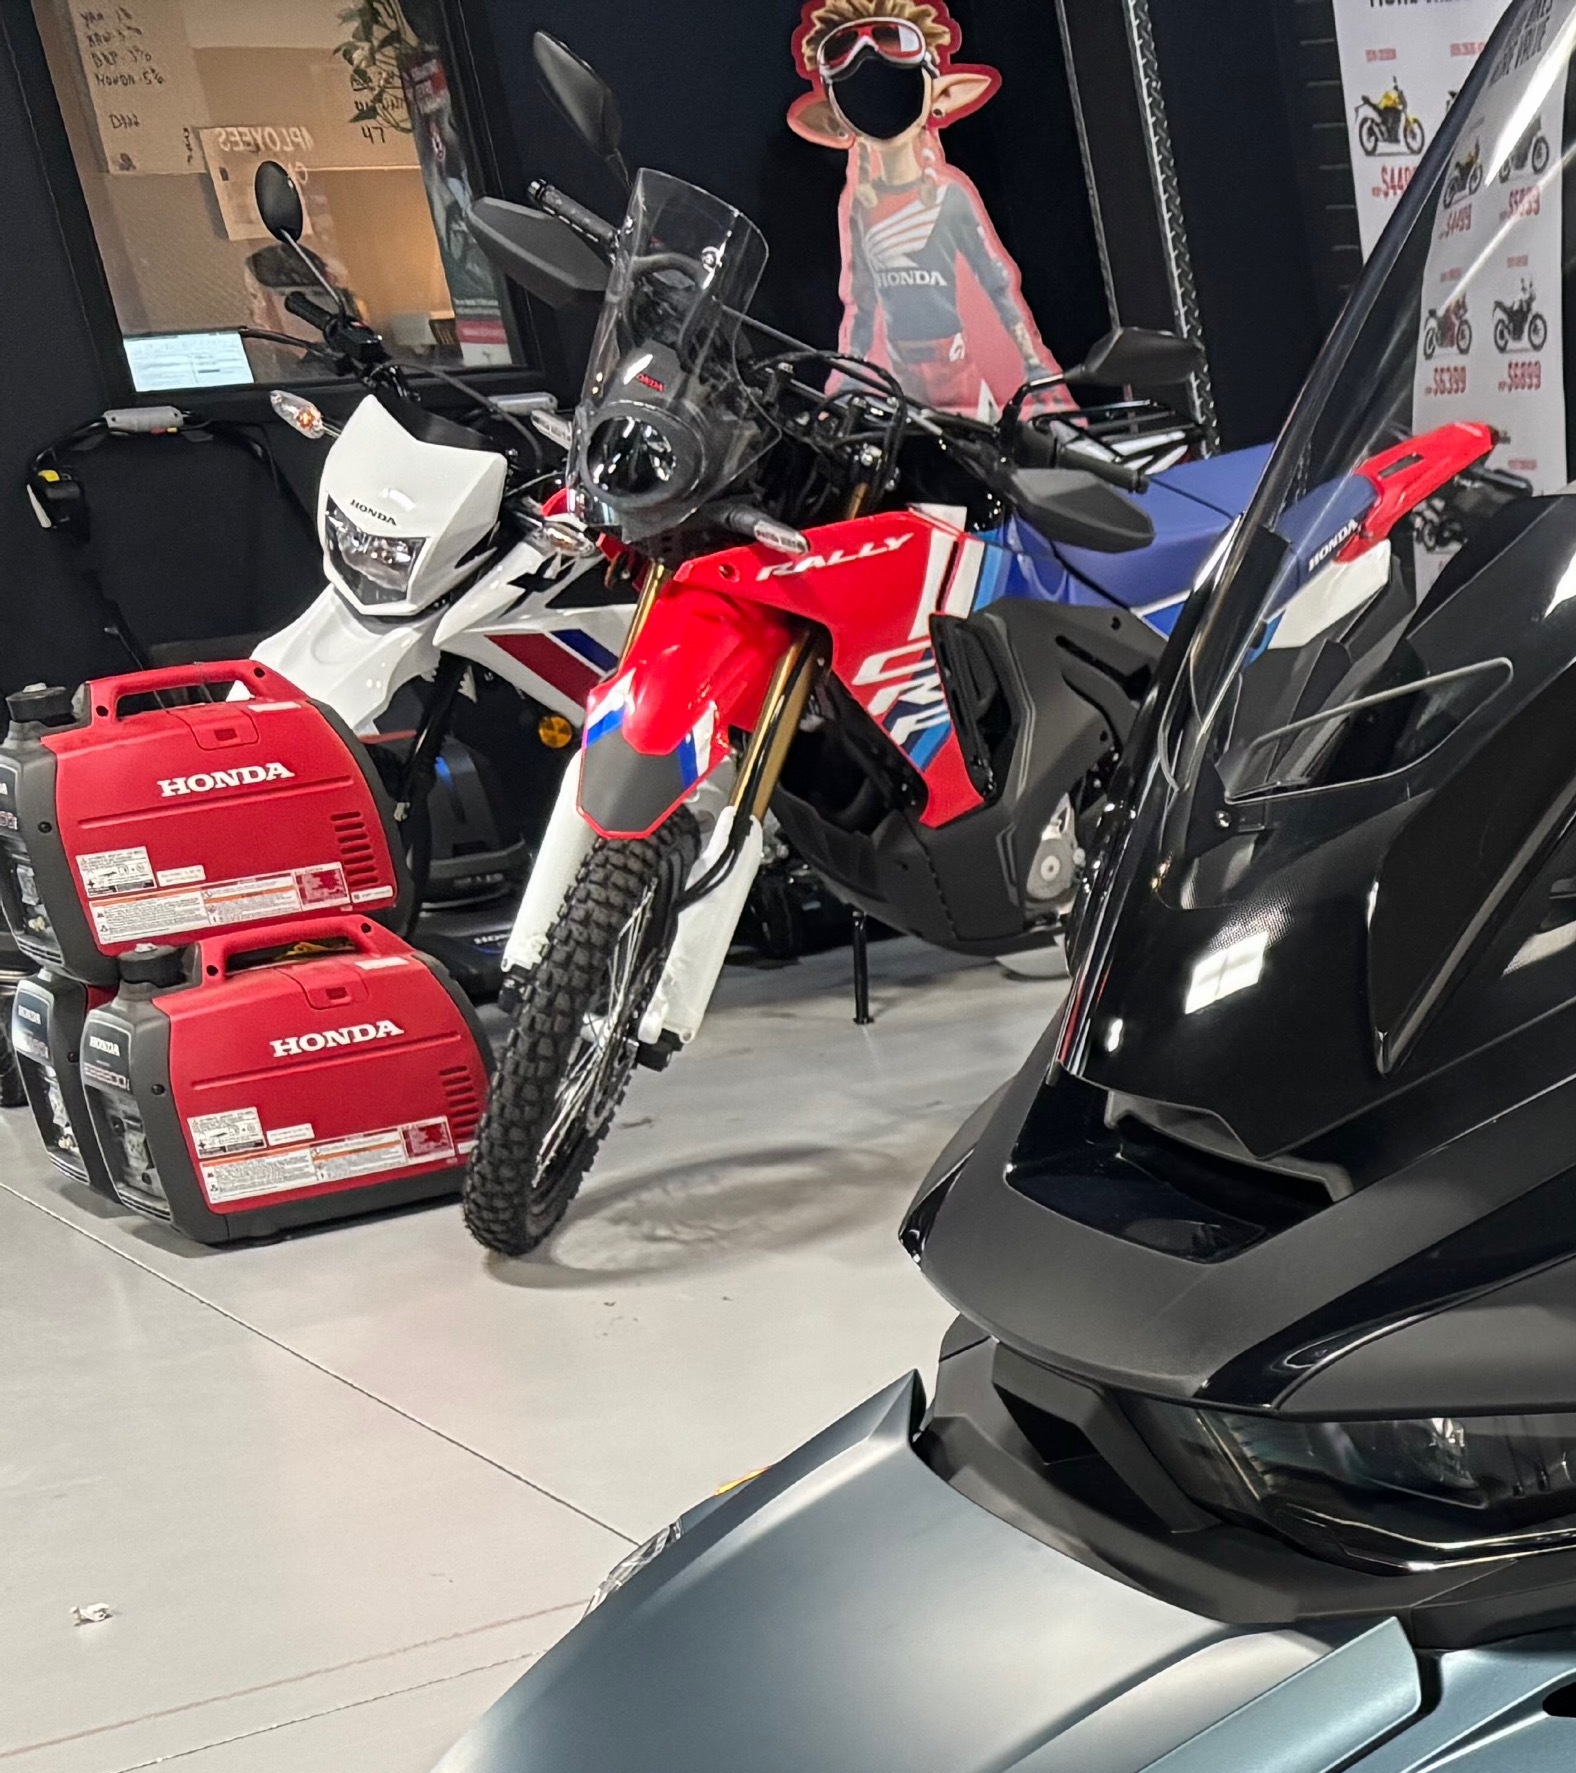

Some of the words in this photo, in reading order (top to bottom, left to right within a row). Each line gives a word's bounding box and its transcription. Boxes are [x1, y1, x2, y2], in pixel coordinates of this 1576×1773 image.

[350, 499, 398, 526] HONDA
[756, 532, 915, 582] RALLY
[1308, 519, 1359, 571] HONDA
[158, 762, 295, 798] HONDA
[269, 1019, 405, 1058] HONDA
